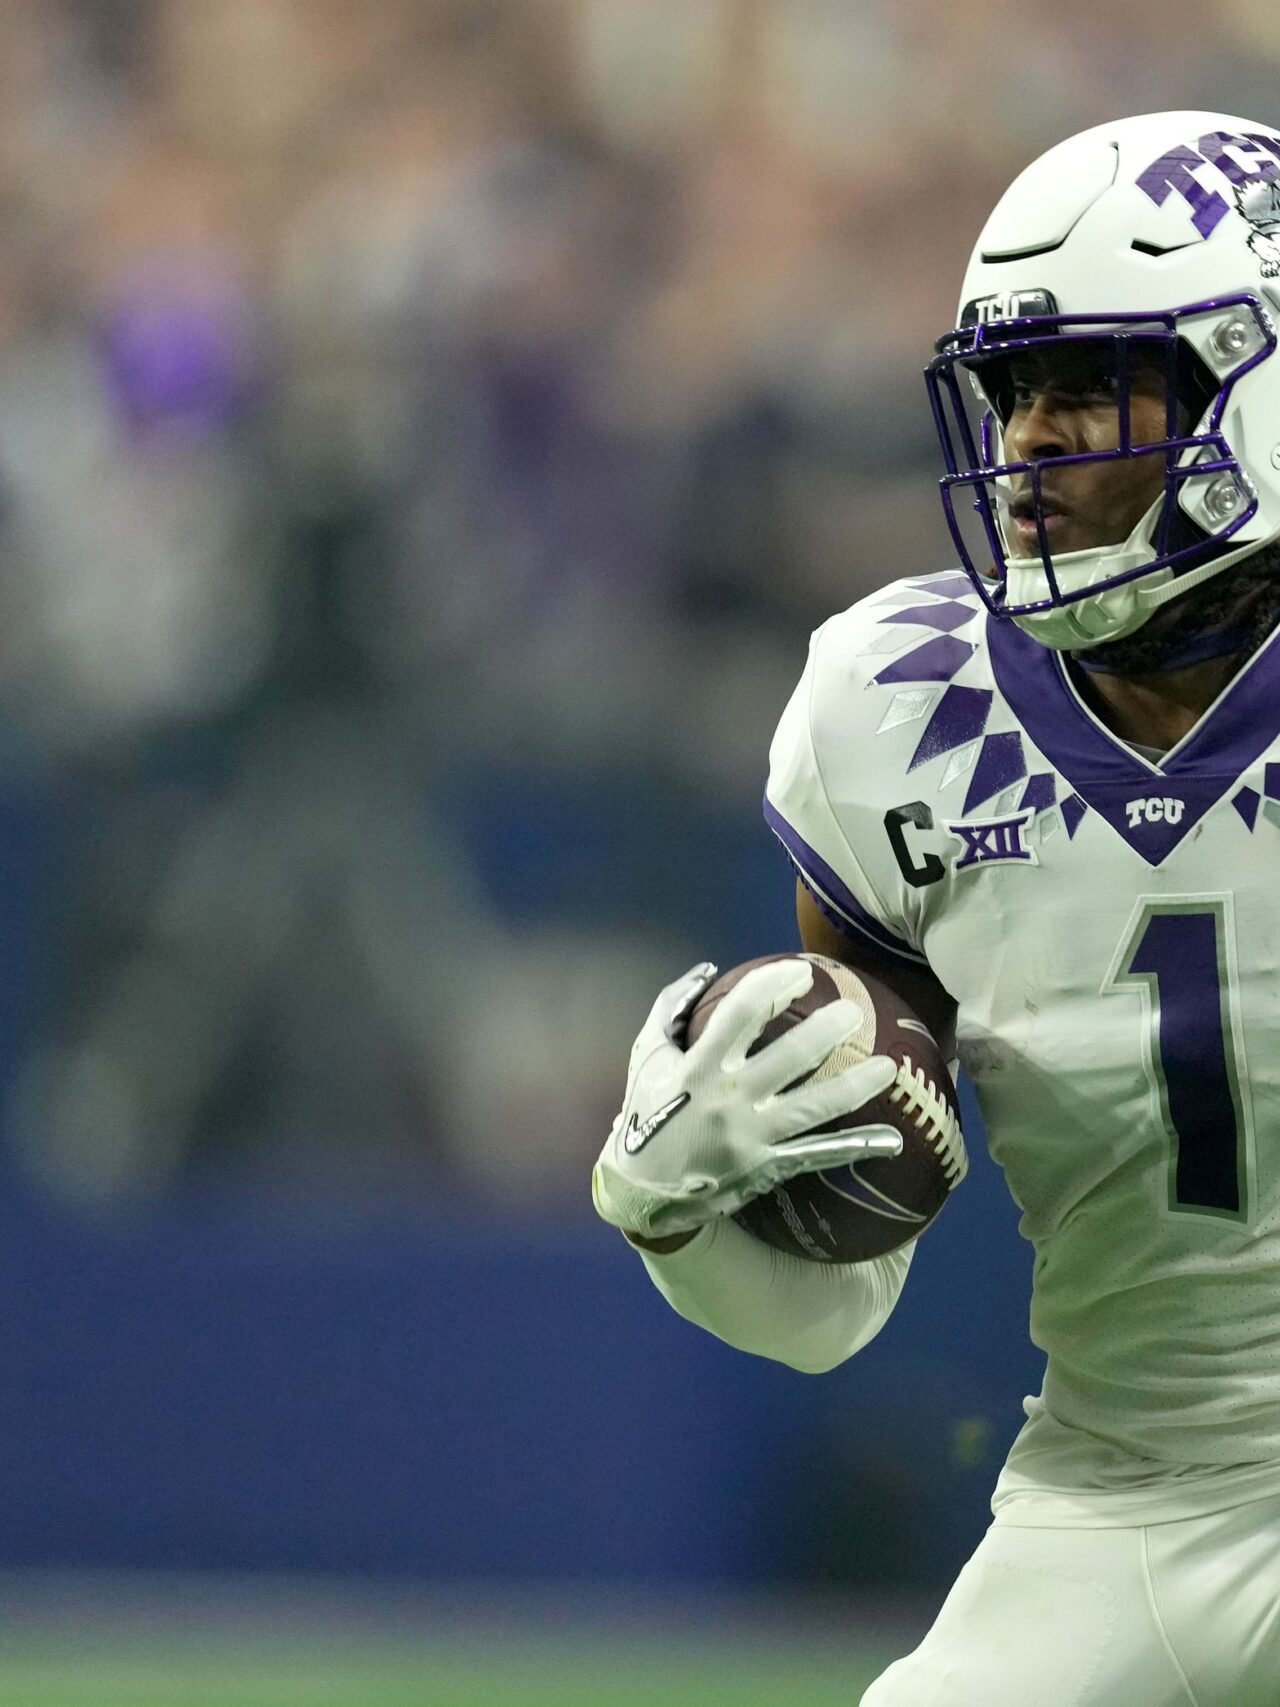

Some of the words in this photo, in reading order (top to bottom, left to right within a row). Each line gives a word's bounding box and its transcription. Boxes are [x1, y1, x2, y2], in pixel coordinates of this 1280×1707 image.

[976, 292, 1020, 324] TCU
[1125, 797, 1185, 828] TCU
[884, 801, 945, 888] C
[949, 815, 1032, 870] XII
[1108, 896, 1251, 1227] 1
